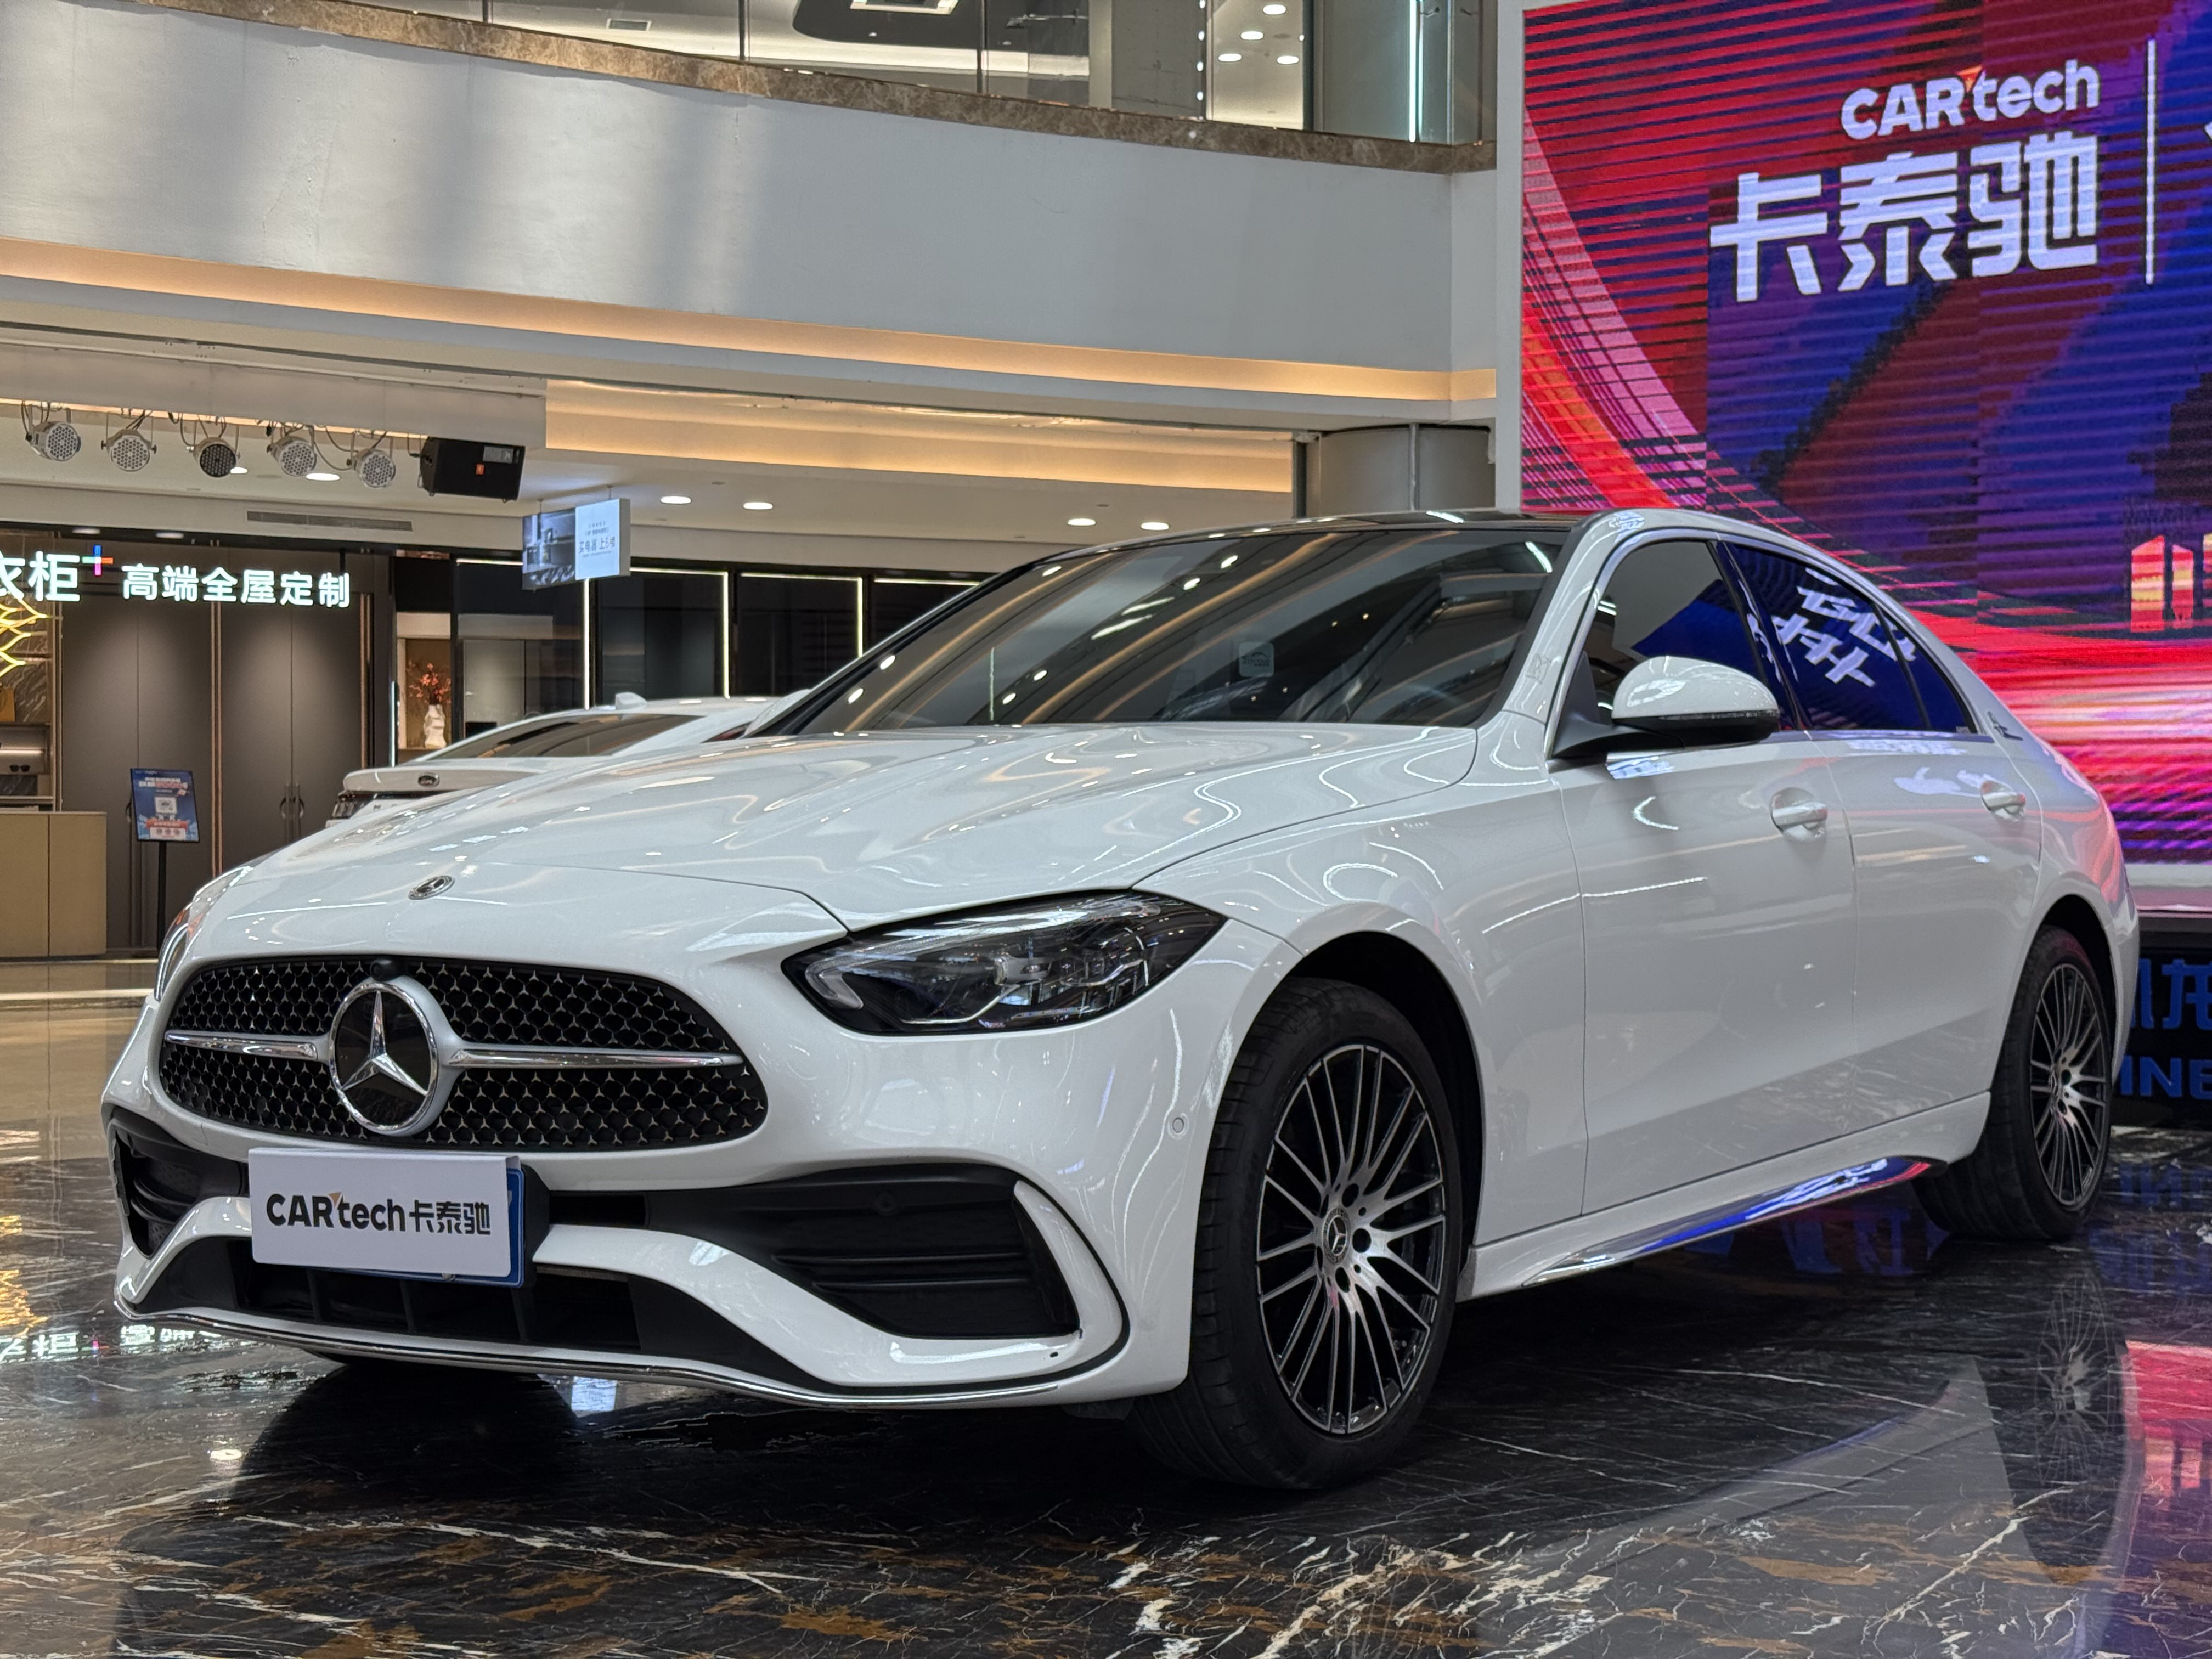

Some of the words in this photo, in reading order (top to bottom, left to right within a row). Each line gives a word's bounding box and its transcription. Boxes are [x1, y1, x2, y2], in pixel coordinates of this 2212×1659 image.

[1841, 58, 2101, 140] CARtech
[1709, 130, 2100, 303] 卡泰驰
[121, 563, 351, 608] 高端全屋定制
[266, 1192, 405, 1232] CARtech
[409, 1199, 491, 1235] 卡泰驰
